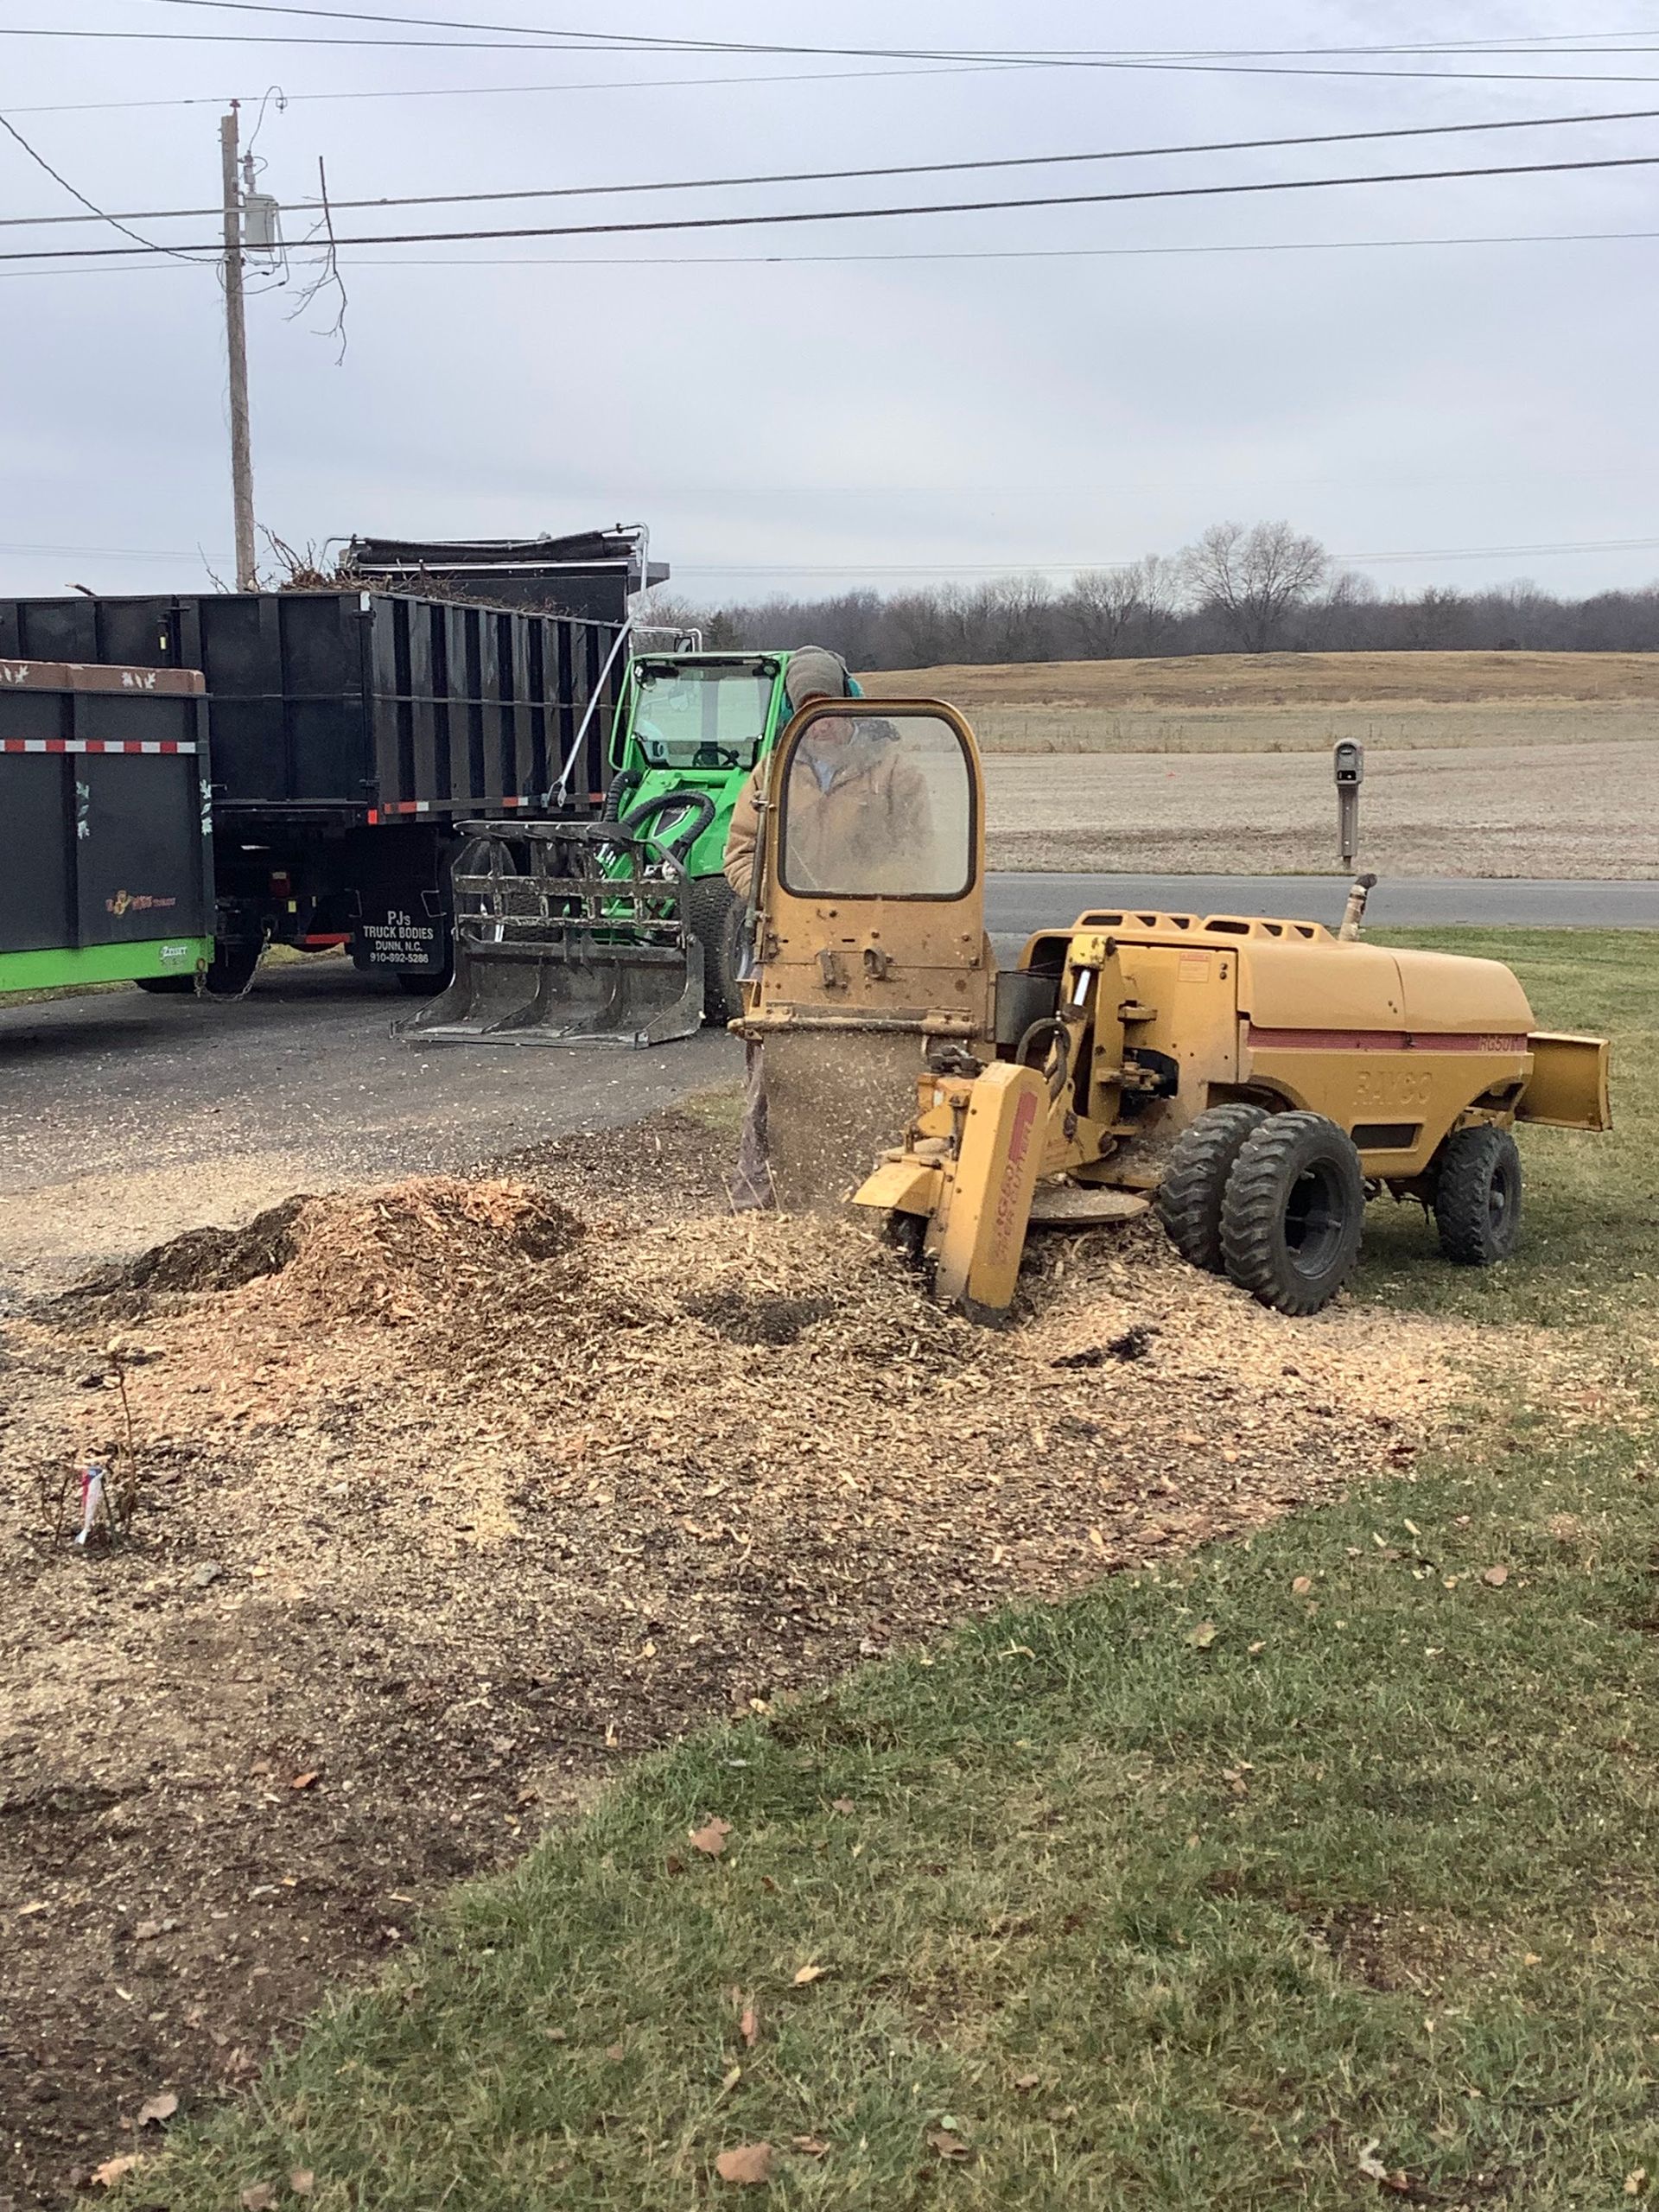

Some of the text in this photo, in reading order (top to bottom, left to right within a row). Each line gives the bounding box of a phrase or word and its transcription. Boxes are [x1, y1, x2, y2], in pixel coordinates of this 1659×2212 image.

[387, 910, 411, 925] PJs
[363, 925, 434, 940] TRUCK BODIES
[375, 940, 423, 952] DUNN, N.C.
